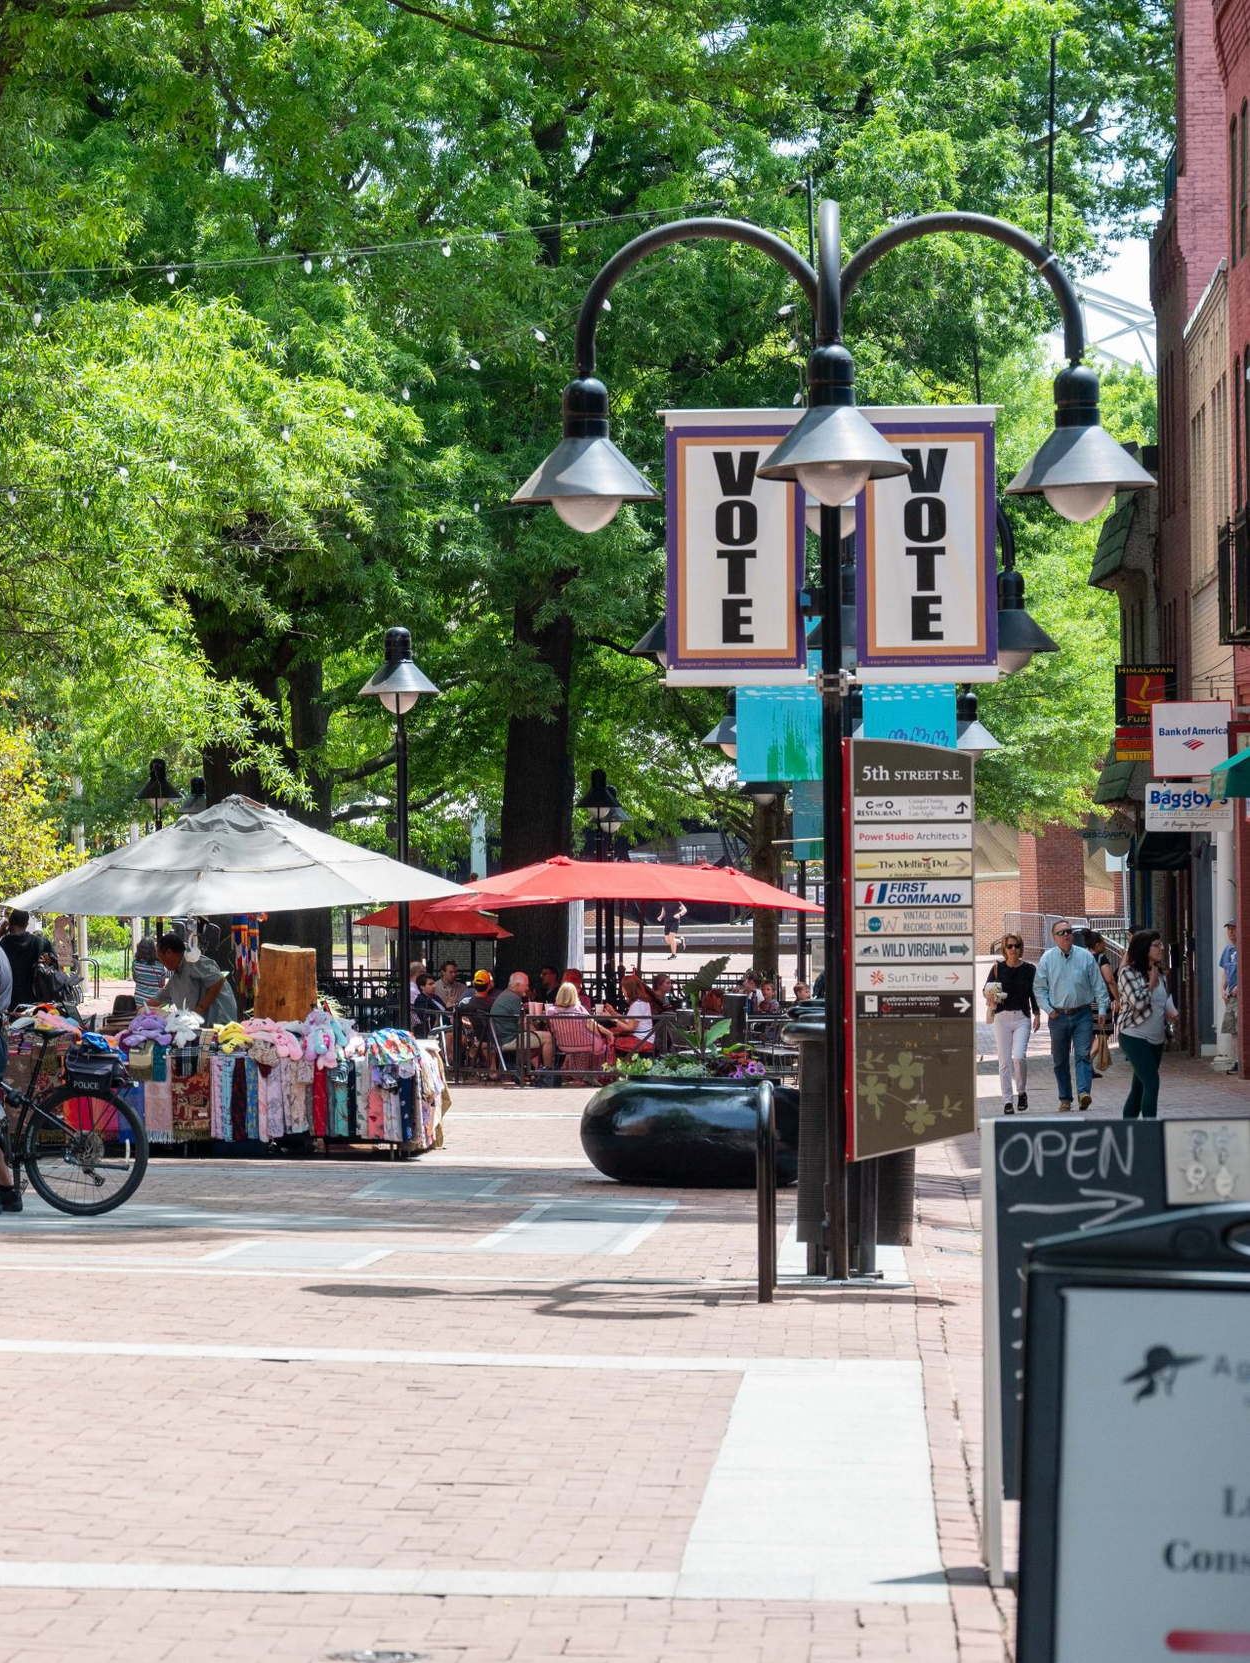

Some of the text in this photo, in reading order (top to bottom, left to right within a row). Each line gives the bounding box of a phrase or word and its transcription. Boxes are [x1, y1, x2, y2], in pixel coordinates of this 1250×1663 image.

[712, 451, 760, 644] VOTE
[901, 448, 949, 641] VOTE
[1127, 715, 1150, 723] FUSI
[1158, 727, 1182, 736] Bank
[1182, 727, 1191, 736] of
[1192, 726, 1228, 735] America
[862, 765, 963, 781] 5th STREET S.E.
[865, 800, 874, 809] C
[885, 800, 894, 809] O
[859, 831, 960, 841] Powe Studio Architects
[878, 860, 895, 869] The
[890, 882, 928, 892] FIRST
[887, 893, 962, 904] COMMAND
[903, 910, 968, 920] VINTAGE CLOTHING
[903, 922, 968, 932] RECORDS ANTIQUES
[882, 943, 948, 957] WILD VIRGINIA
[887, 973, 939, 983] Sun Tribe
[73, 1081, 99, 1089] POLICE
[1000, 1125, 1134, 1180] OPEN
